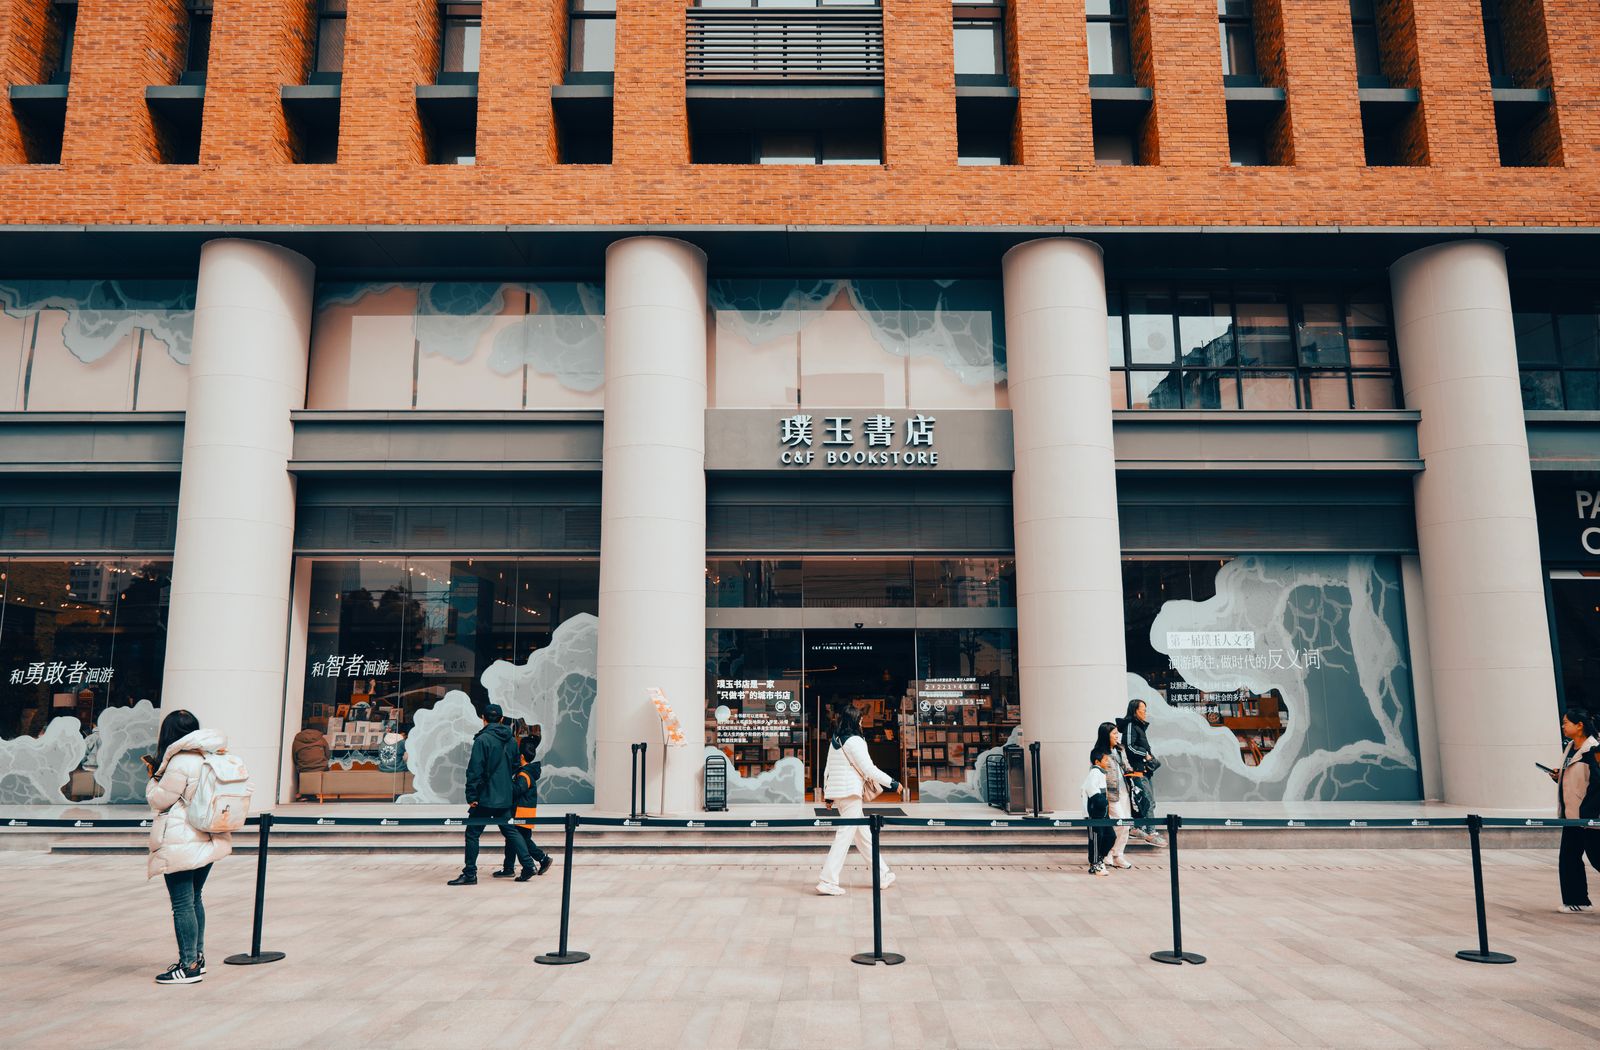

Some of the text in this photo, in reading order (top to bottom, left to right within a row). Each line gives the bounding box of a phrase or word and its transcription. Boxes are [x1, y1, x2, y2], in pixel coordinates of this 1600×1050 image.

[781, 414, 936, 446] 璞玉書店
[781, 451, 938, 465] C&F BOOKSTORE
[9, 660, 115, 685] 和勇敢者洄游
[311, 653, 390, 678] 和智者洄游
[716, 679, 775, 689] 璞玉书店是一家
